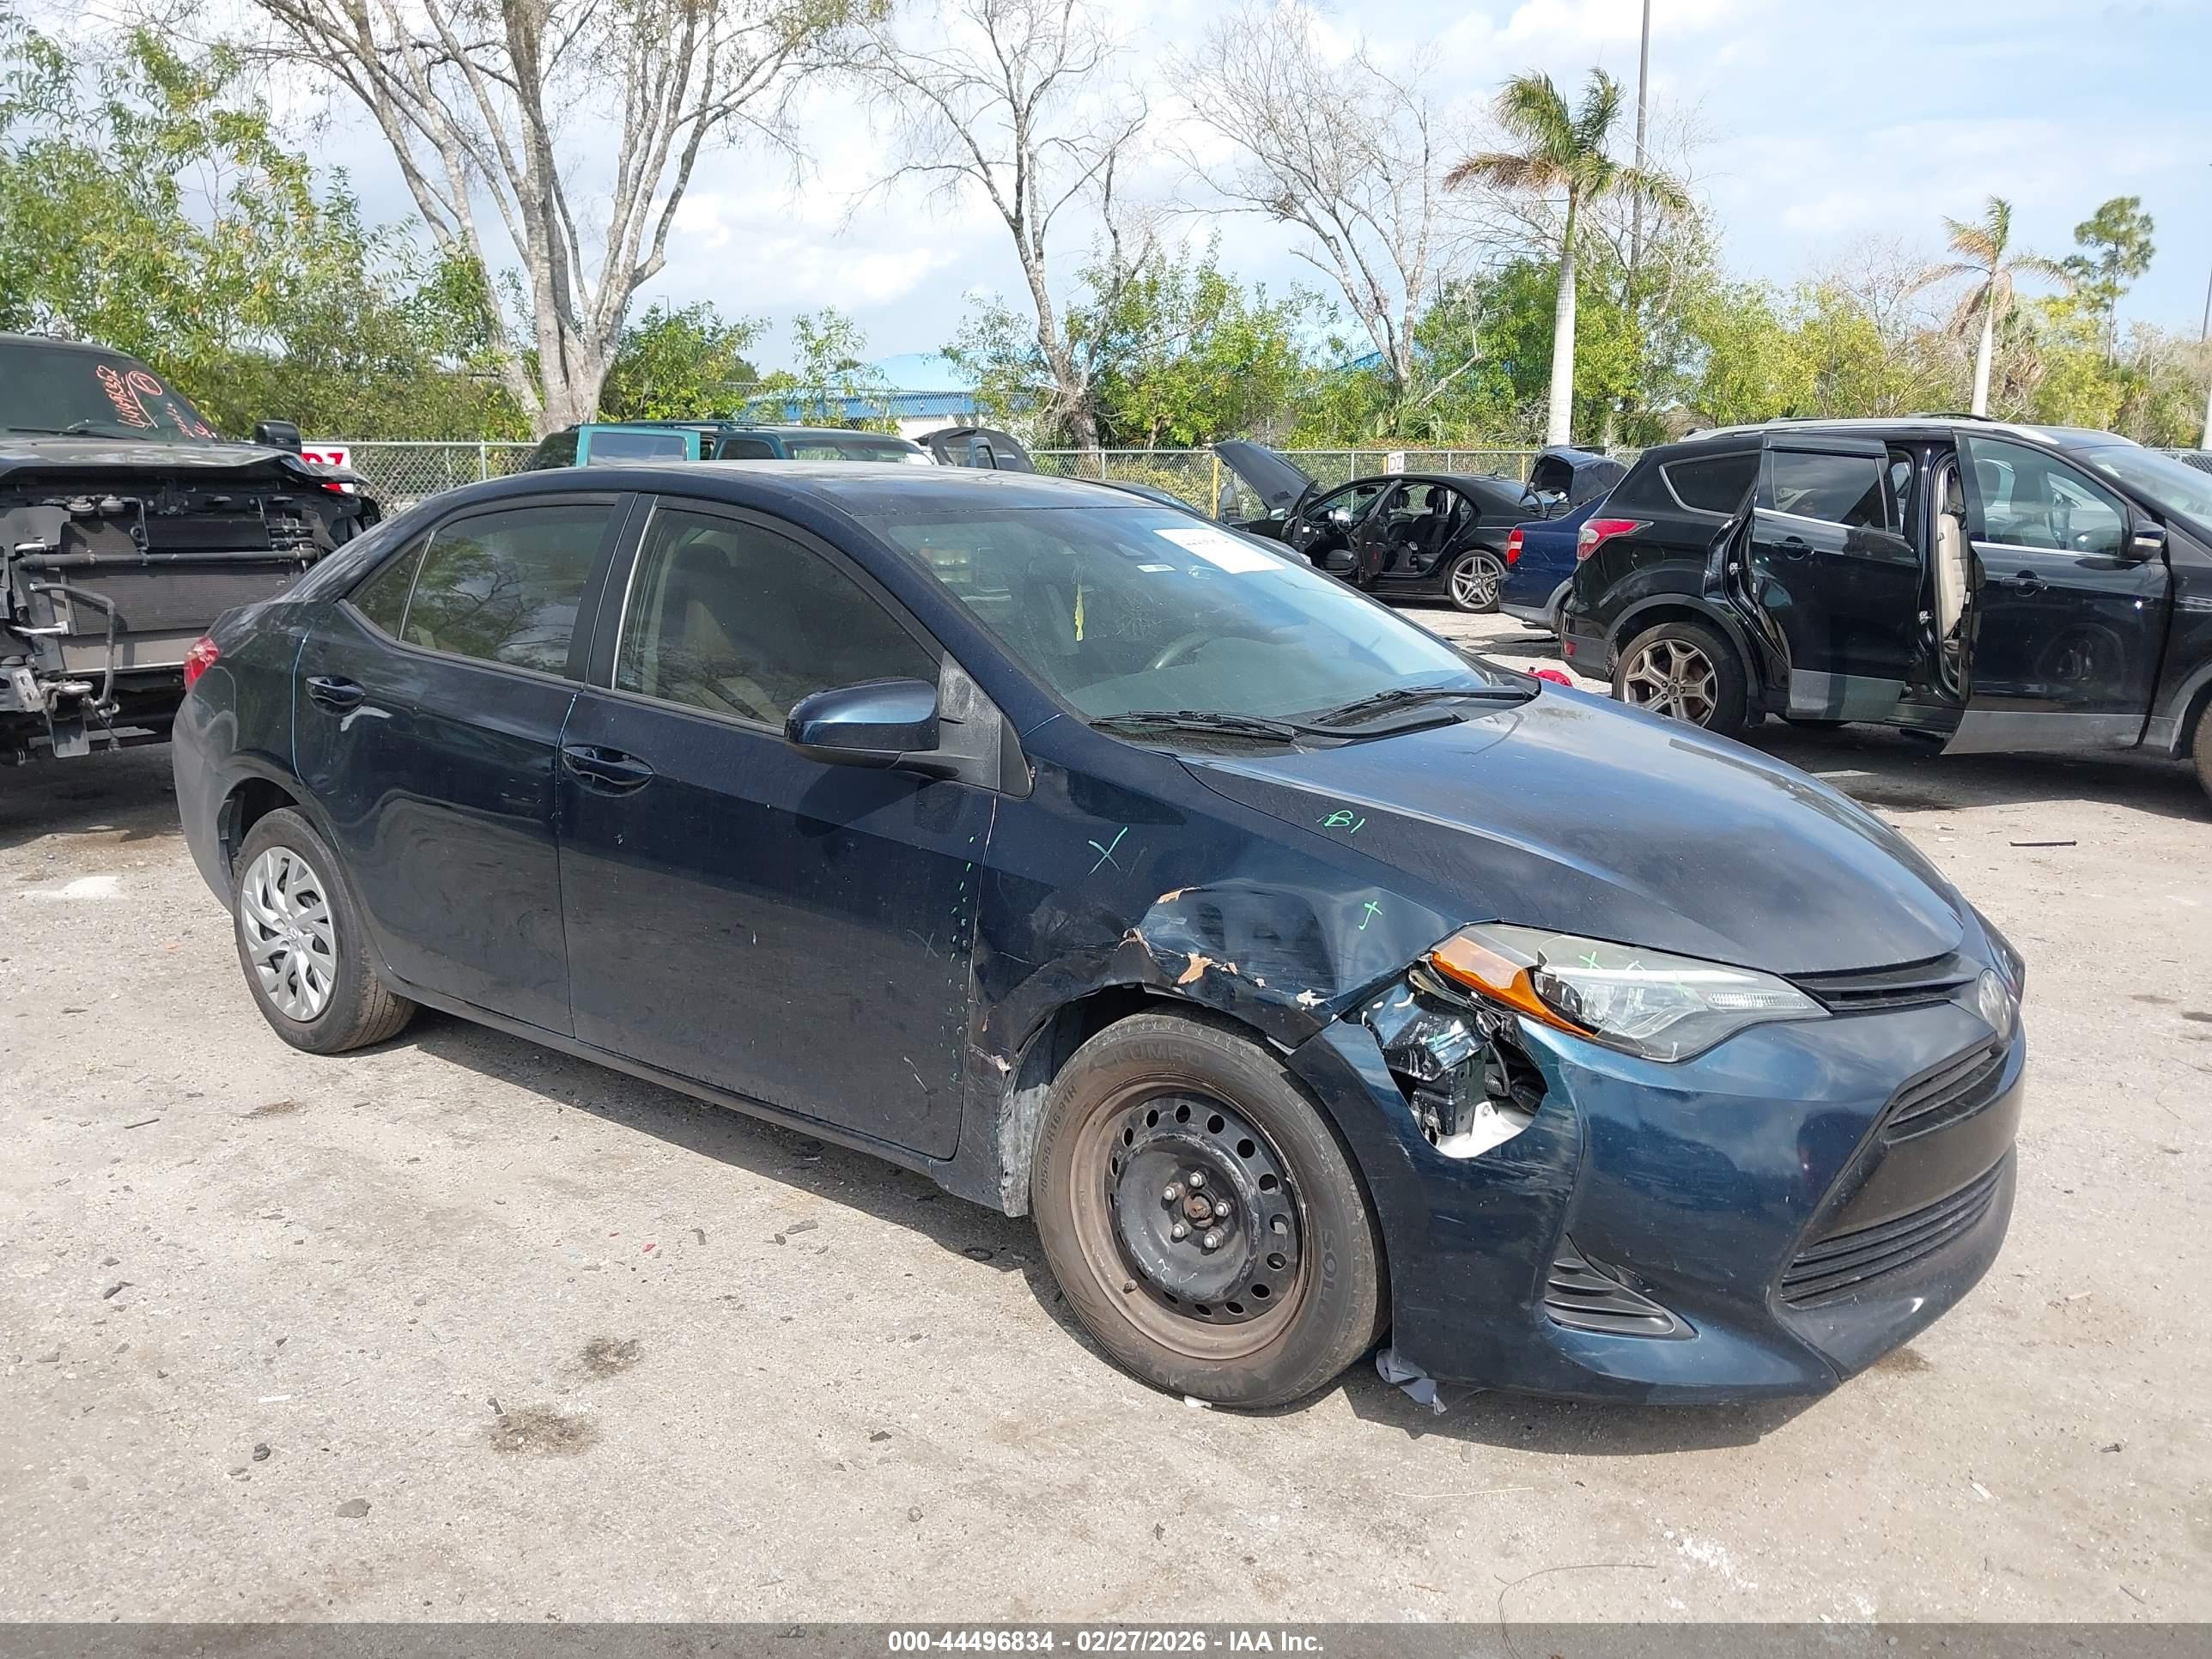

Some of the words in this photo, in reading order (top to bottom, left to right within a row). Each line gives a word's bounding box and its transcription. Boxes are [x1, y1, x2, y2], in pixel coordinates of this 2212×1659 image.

[1389, 454, 1403, 471] DZ
[1057, 1084, 1079, 1115] 91H
[1046, 1112, 1061, 1143] R16
[1040, 1143, 1053, 1197] 205/55
